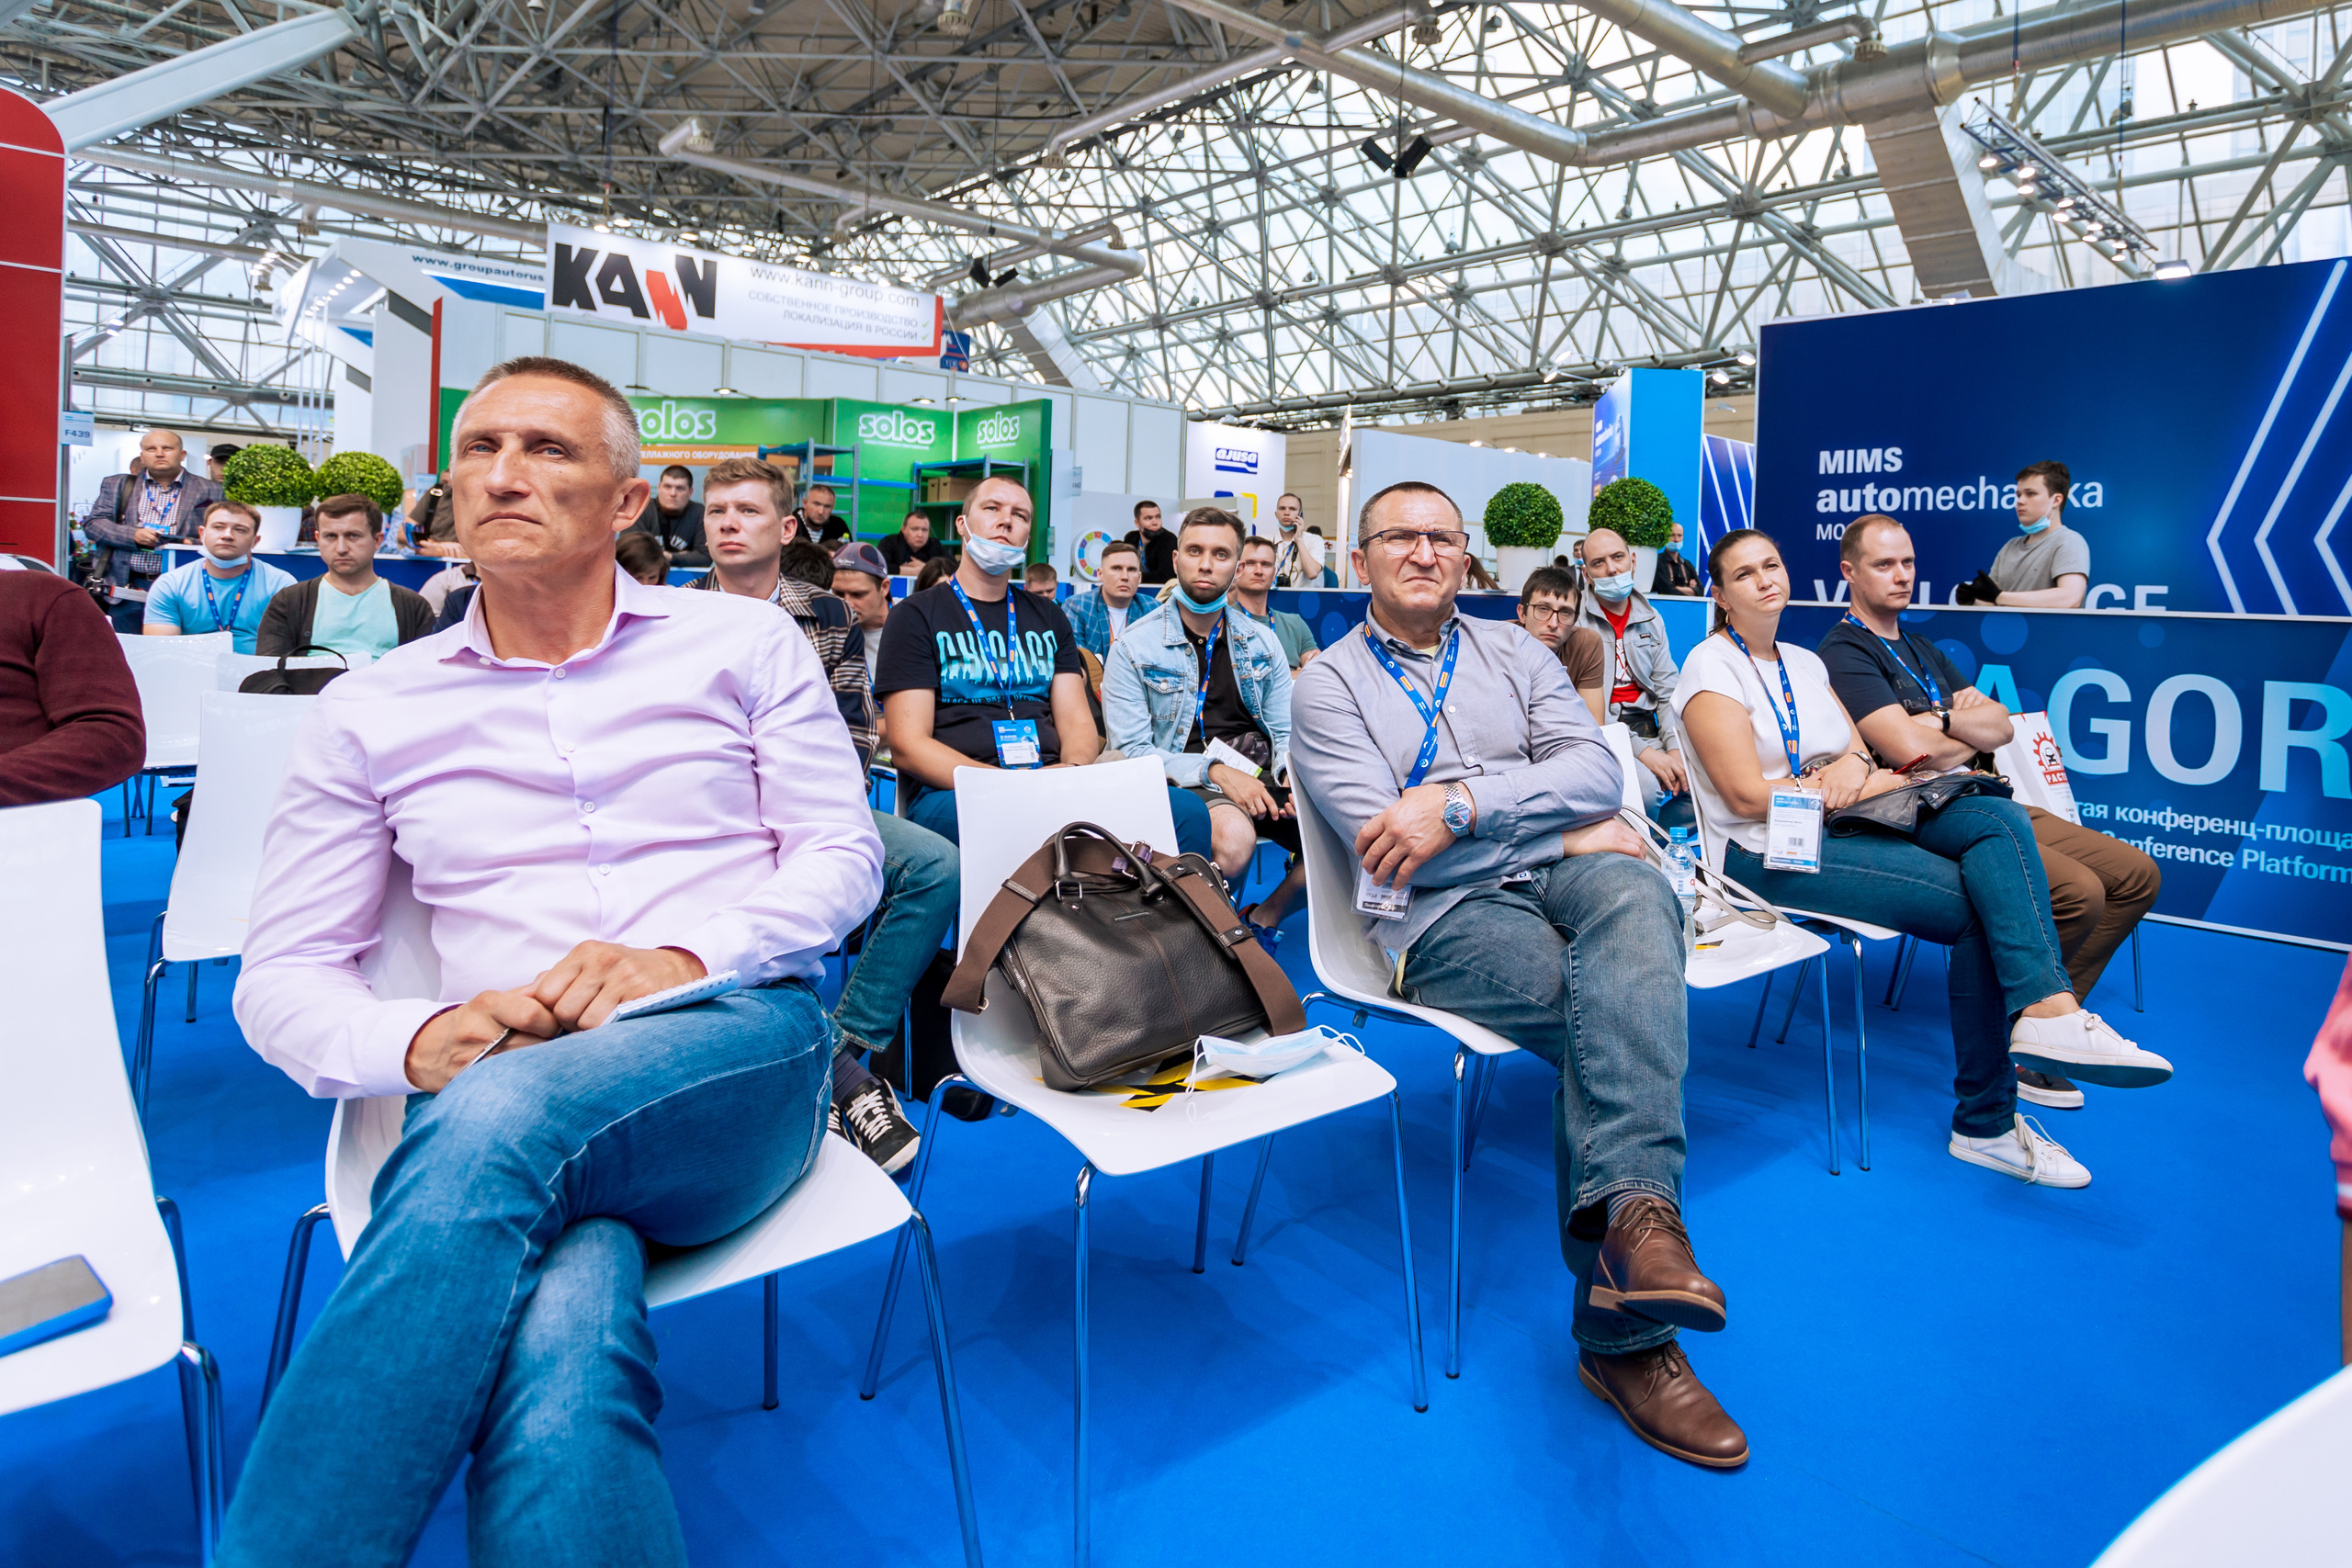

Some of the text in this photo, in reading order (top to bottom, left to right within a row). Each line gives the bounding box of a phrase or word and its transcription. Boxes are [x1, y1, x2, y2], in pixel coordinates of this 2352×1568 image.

[552, 243, 717, 331] KANN
[750, 265, 919, 308] www.kann-group.com
[748, 290, 918, 328] СОБСТВЕННОЕ ПРОИЗВОДСТВО
[783, 310, 918, 341] ЛОКАЛИЗАЦИЯ В РОССИИ
[64, 429, 91, 439] F439
[633, 400, 717, 440] olos
[858, 410, 935, 445] solos
[977, 411, 1020, 445] solos
[640, 450, 690, 459] ЕЛЛАЖНОГО
[1818, 446, 1904, 475] MIMS
[1816, 476, 2104, 513] automechaka
[2242, 849, 2352, 885] Platform
